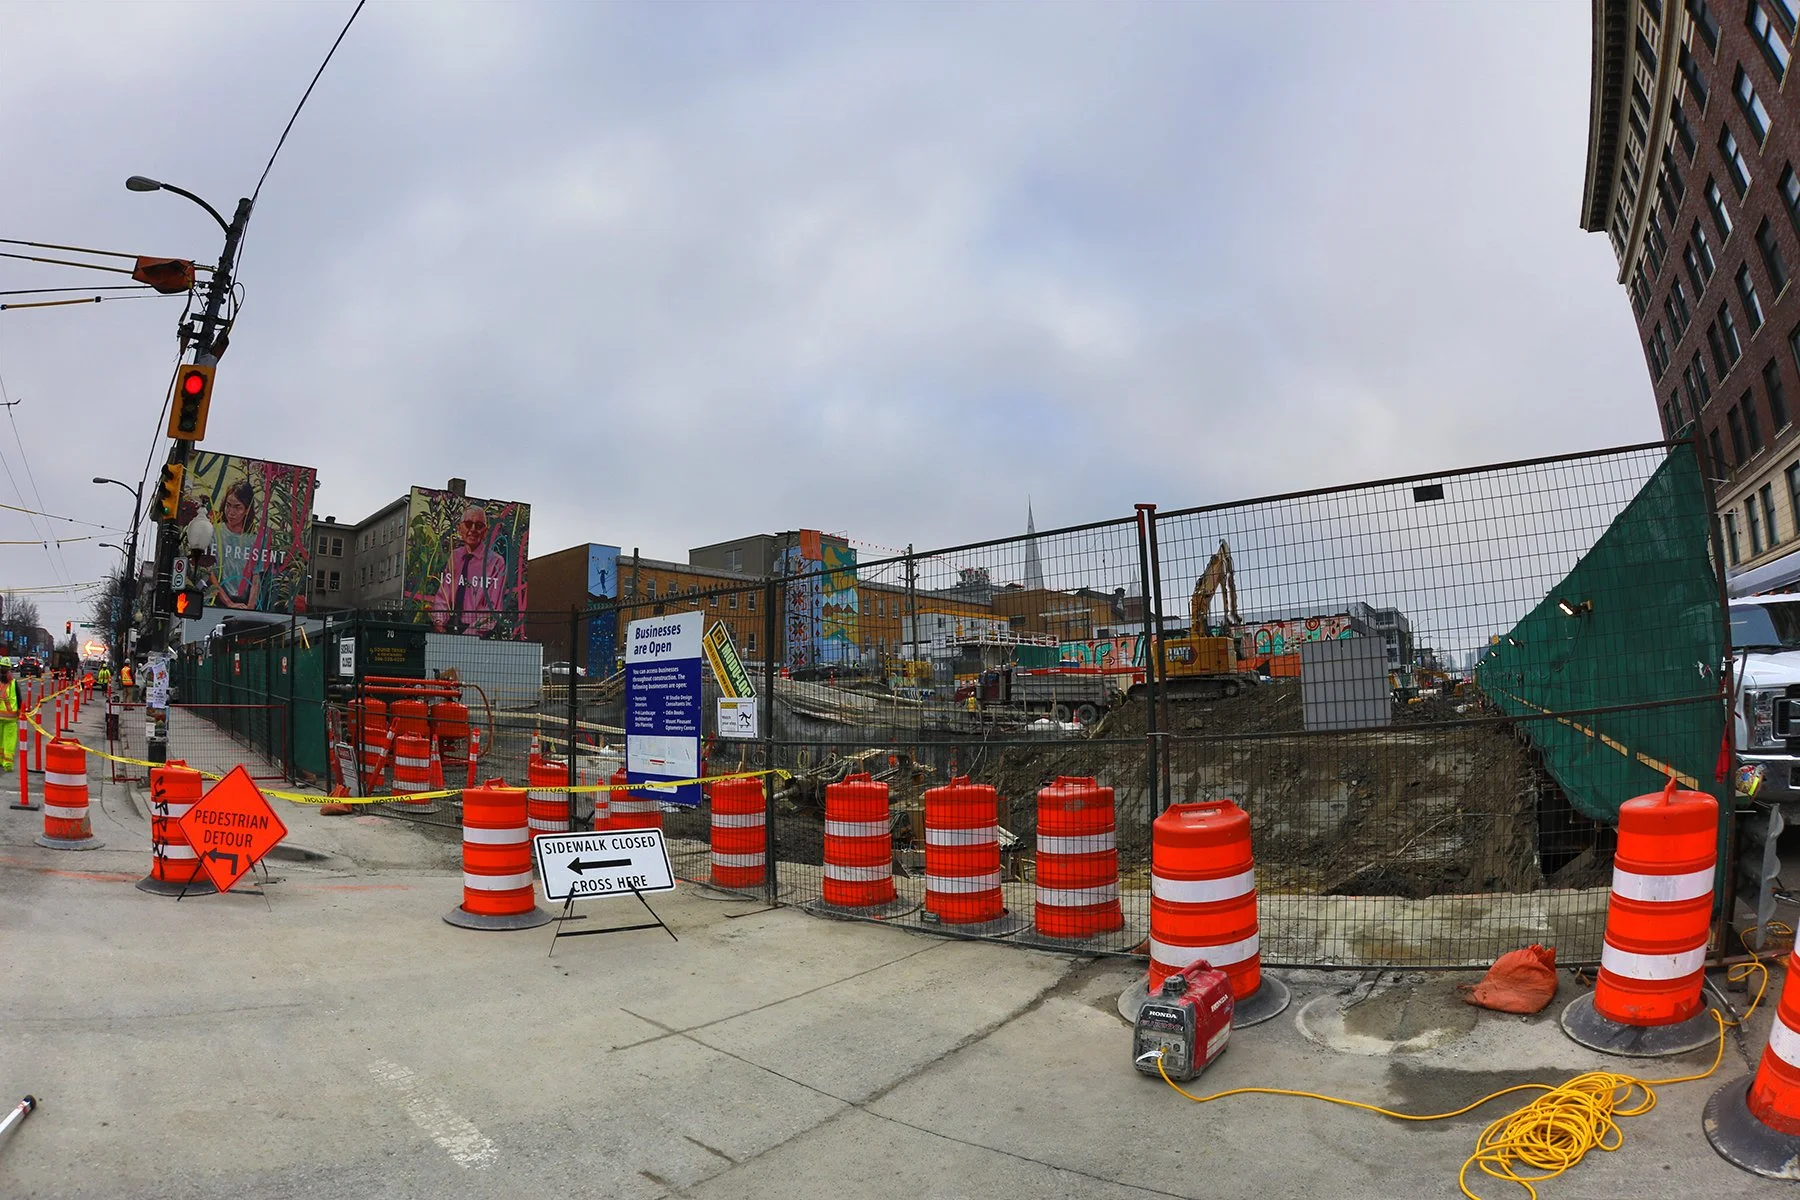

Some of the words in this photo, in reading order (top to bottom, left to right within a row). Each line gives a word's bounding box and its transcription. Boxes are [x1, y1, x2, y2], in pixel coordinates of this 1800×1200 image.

[225, 545, 286, 564] PRESENT
[440, 572, 452, 585] IS
[458, 574, 465, 586] A
[472, 575, 499, 589] GIFT
[387, 630, 395, 638] 70
[635, 624, 681, 639] Businesses
[634, 644, 647, 655] are
[649, 641, 672, 656] Open
[194, 809, 269, 830] PEDESTRIAN
[203, 829, 253, 848] DETOUR
[544, 839, 608, 854] SIDEWALK
[611, 836, 656, 850] CLOSED
[571, 878, 613, 893] CROSS
[616, 875, 648, 889] HERE
[1211, 994, 1229, 1012] HONDA
[1149, 1010, 1178, 1019] HONDA
